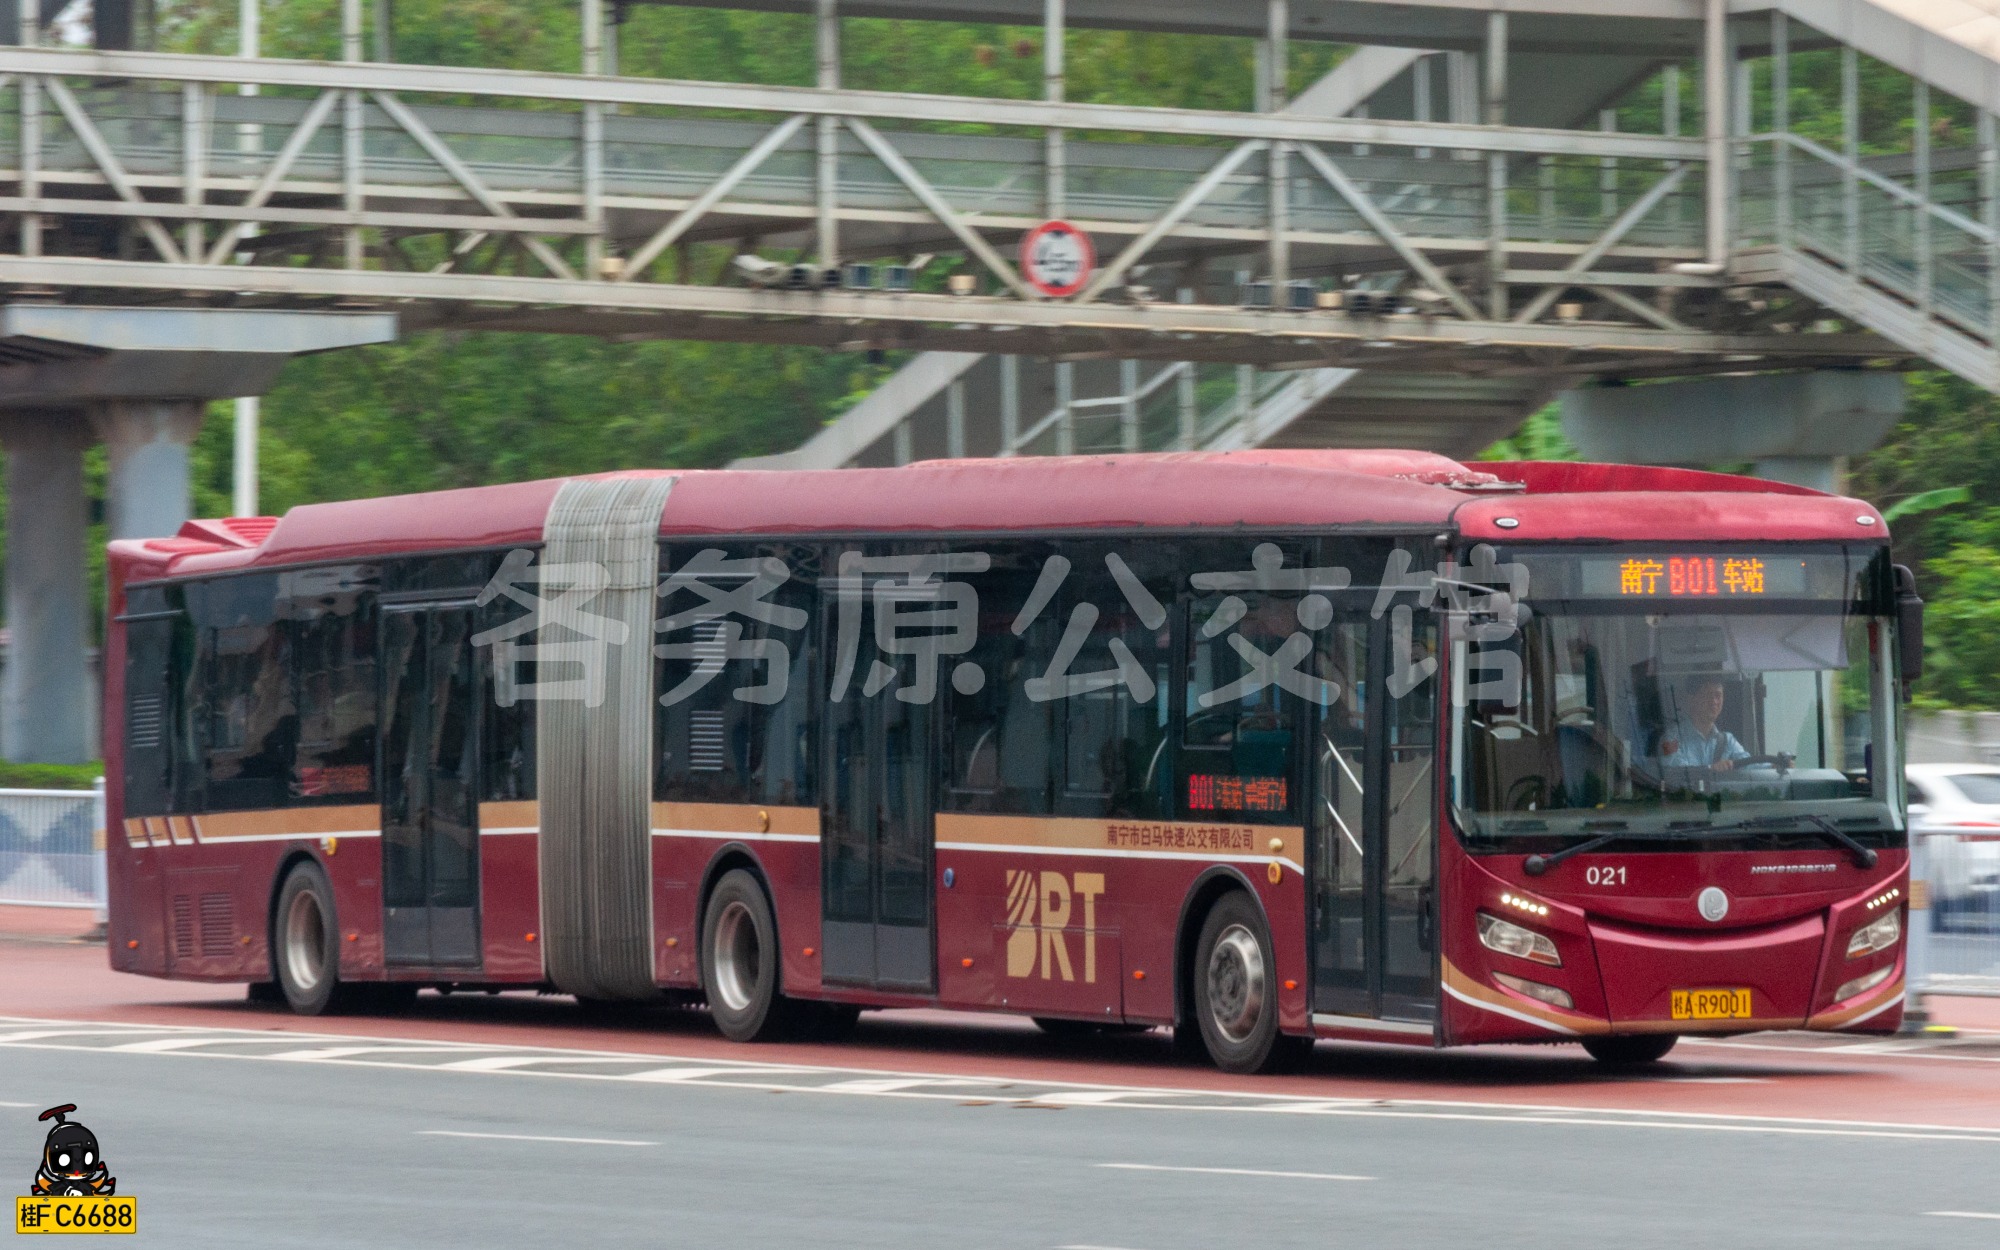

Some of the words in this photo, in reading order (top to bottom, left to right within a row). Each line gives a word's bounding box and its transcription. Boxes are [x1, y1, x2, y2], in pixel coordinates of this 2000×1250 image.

[1620, 559, 1663, 594] 南宁
[1668, 557, 1718, 595] B01
[1723, 558, 1764, 593] 车站
[1188, 773, 1214, 810] B01
[1107, 824, 1253, 850] 南宁市白马快速公交有限公司
[1586, 866, 1626, 885] 021
[1006, 869, 1105, 983] BRT
